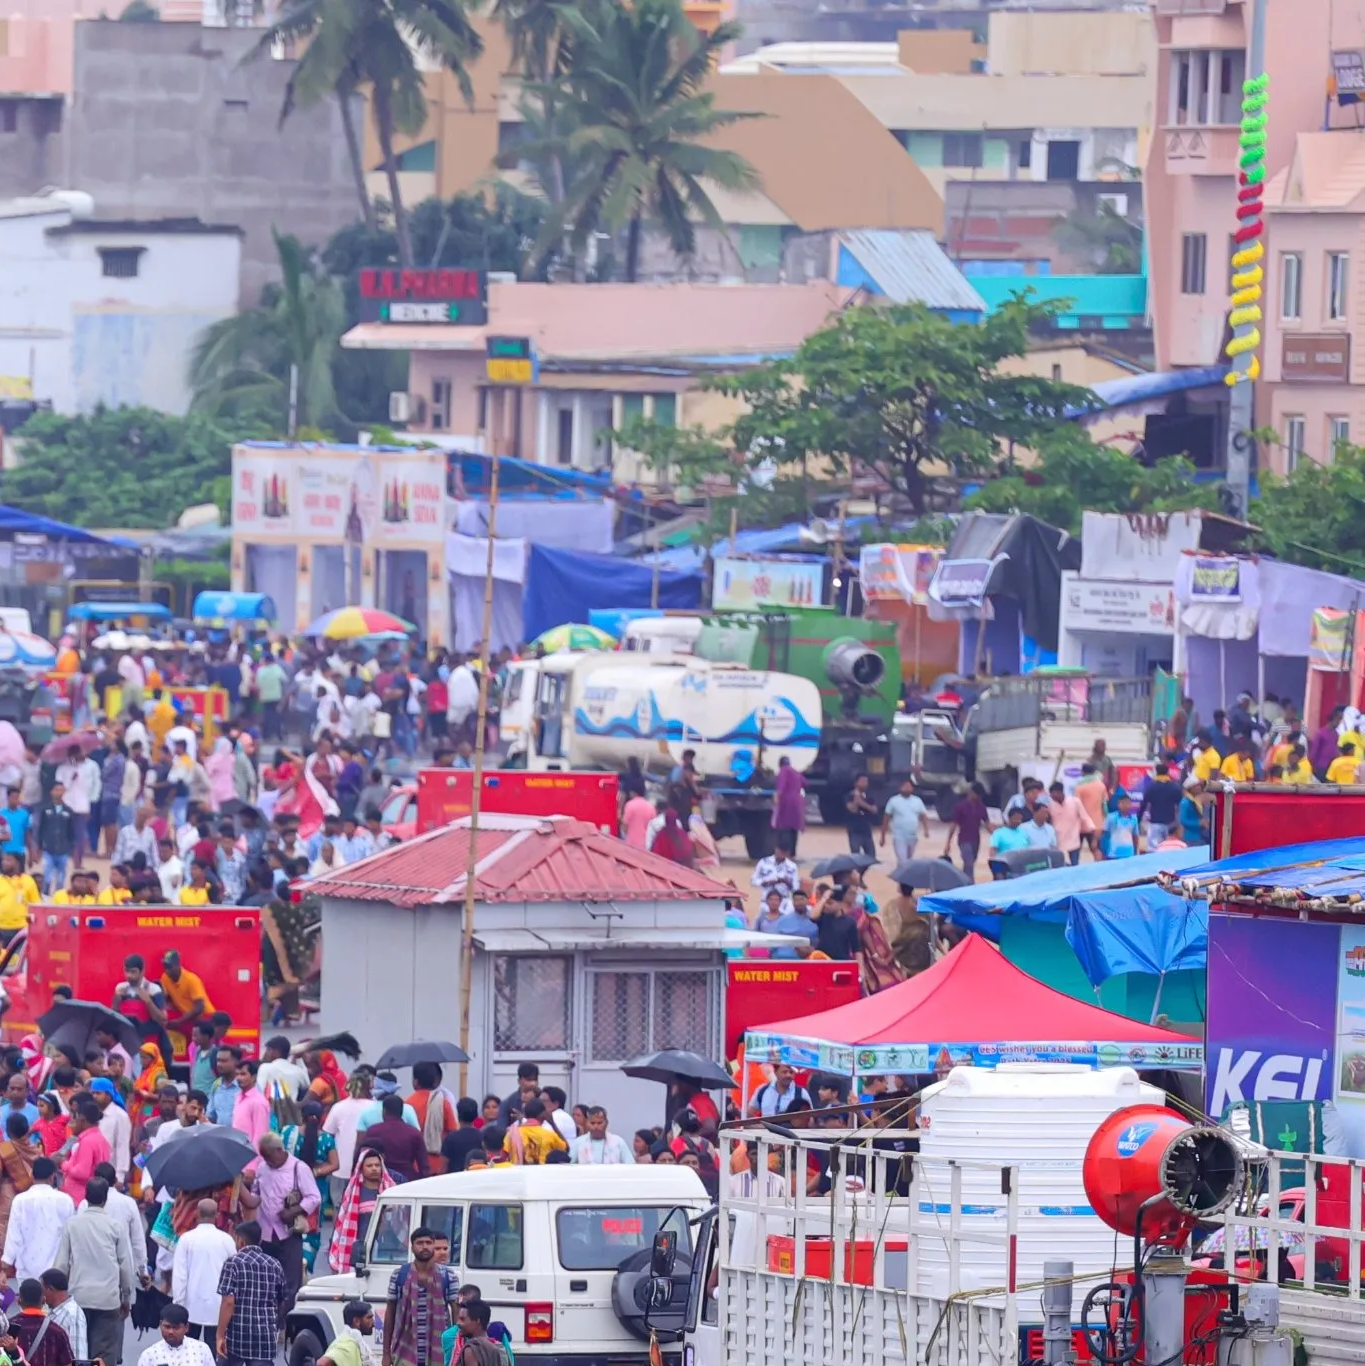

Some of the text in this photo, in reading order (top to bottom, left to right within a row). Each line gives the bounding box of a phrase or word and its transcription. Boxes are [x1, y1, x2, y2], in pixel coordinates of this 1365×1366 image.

[136, 916, 201, 927] WATER MIST
[733, 970, 799, 982] WATER MIST
[997, 1044, 1031, 1054] wishes
[1032, 1044, 1049, 1055] you
[1058, 1043, 1093, 1054] blessed
[1210, 1047, 1323, 1117] KEI
[602, 1219, 644, 1234] POLICE
